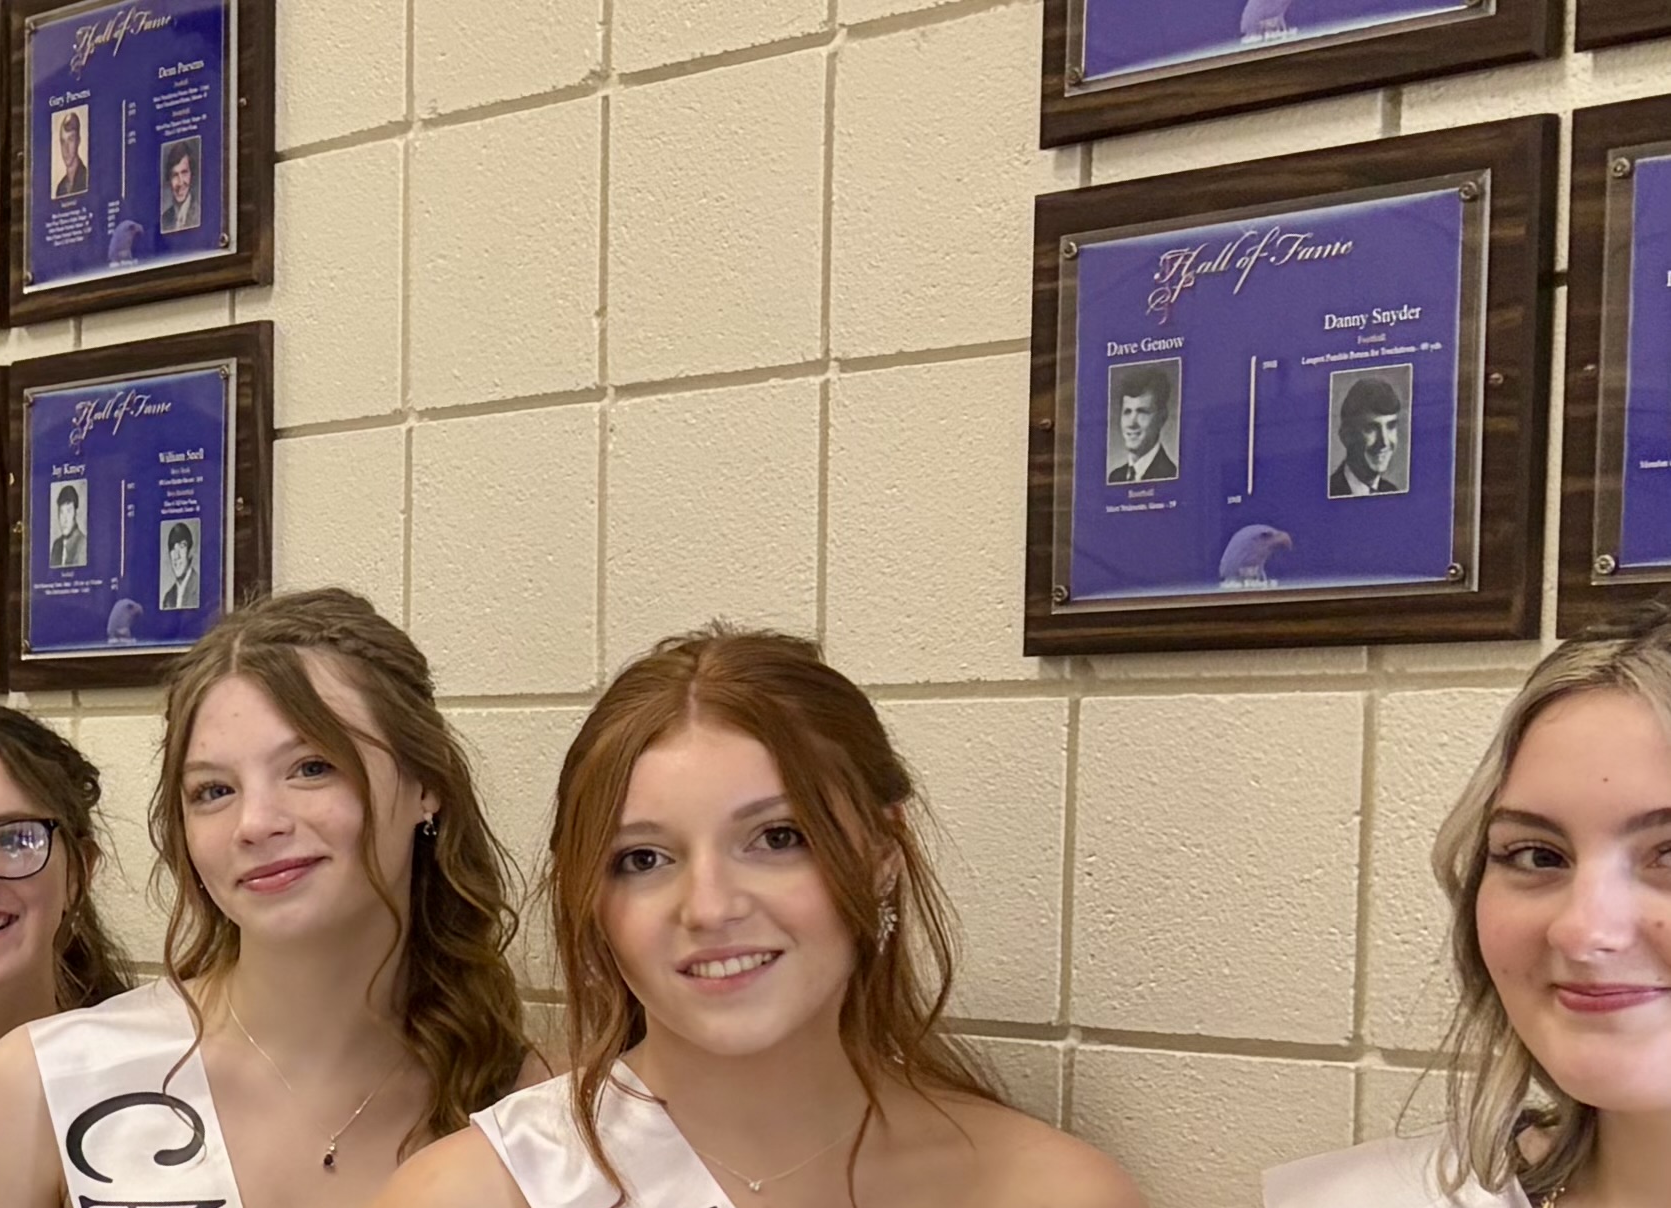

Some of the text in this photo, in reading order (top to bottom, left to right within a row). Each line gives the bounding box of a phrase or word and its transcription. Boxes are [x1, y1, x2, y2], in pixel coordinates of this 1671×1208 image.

[70, 6, 172, 70] Hall of Fame
[1146, 226, 1353, 308] Hall of Fame
[1324, 304, 1422, 330] Danny Snyder
[1106, 336, 1185, 357] Dave Genow
[70, 388, 172, 443] Hall of Fame
